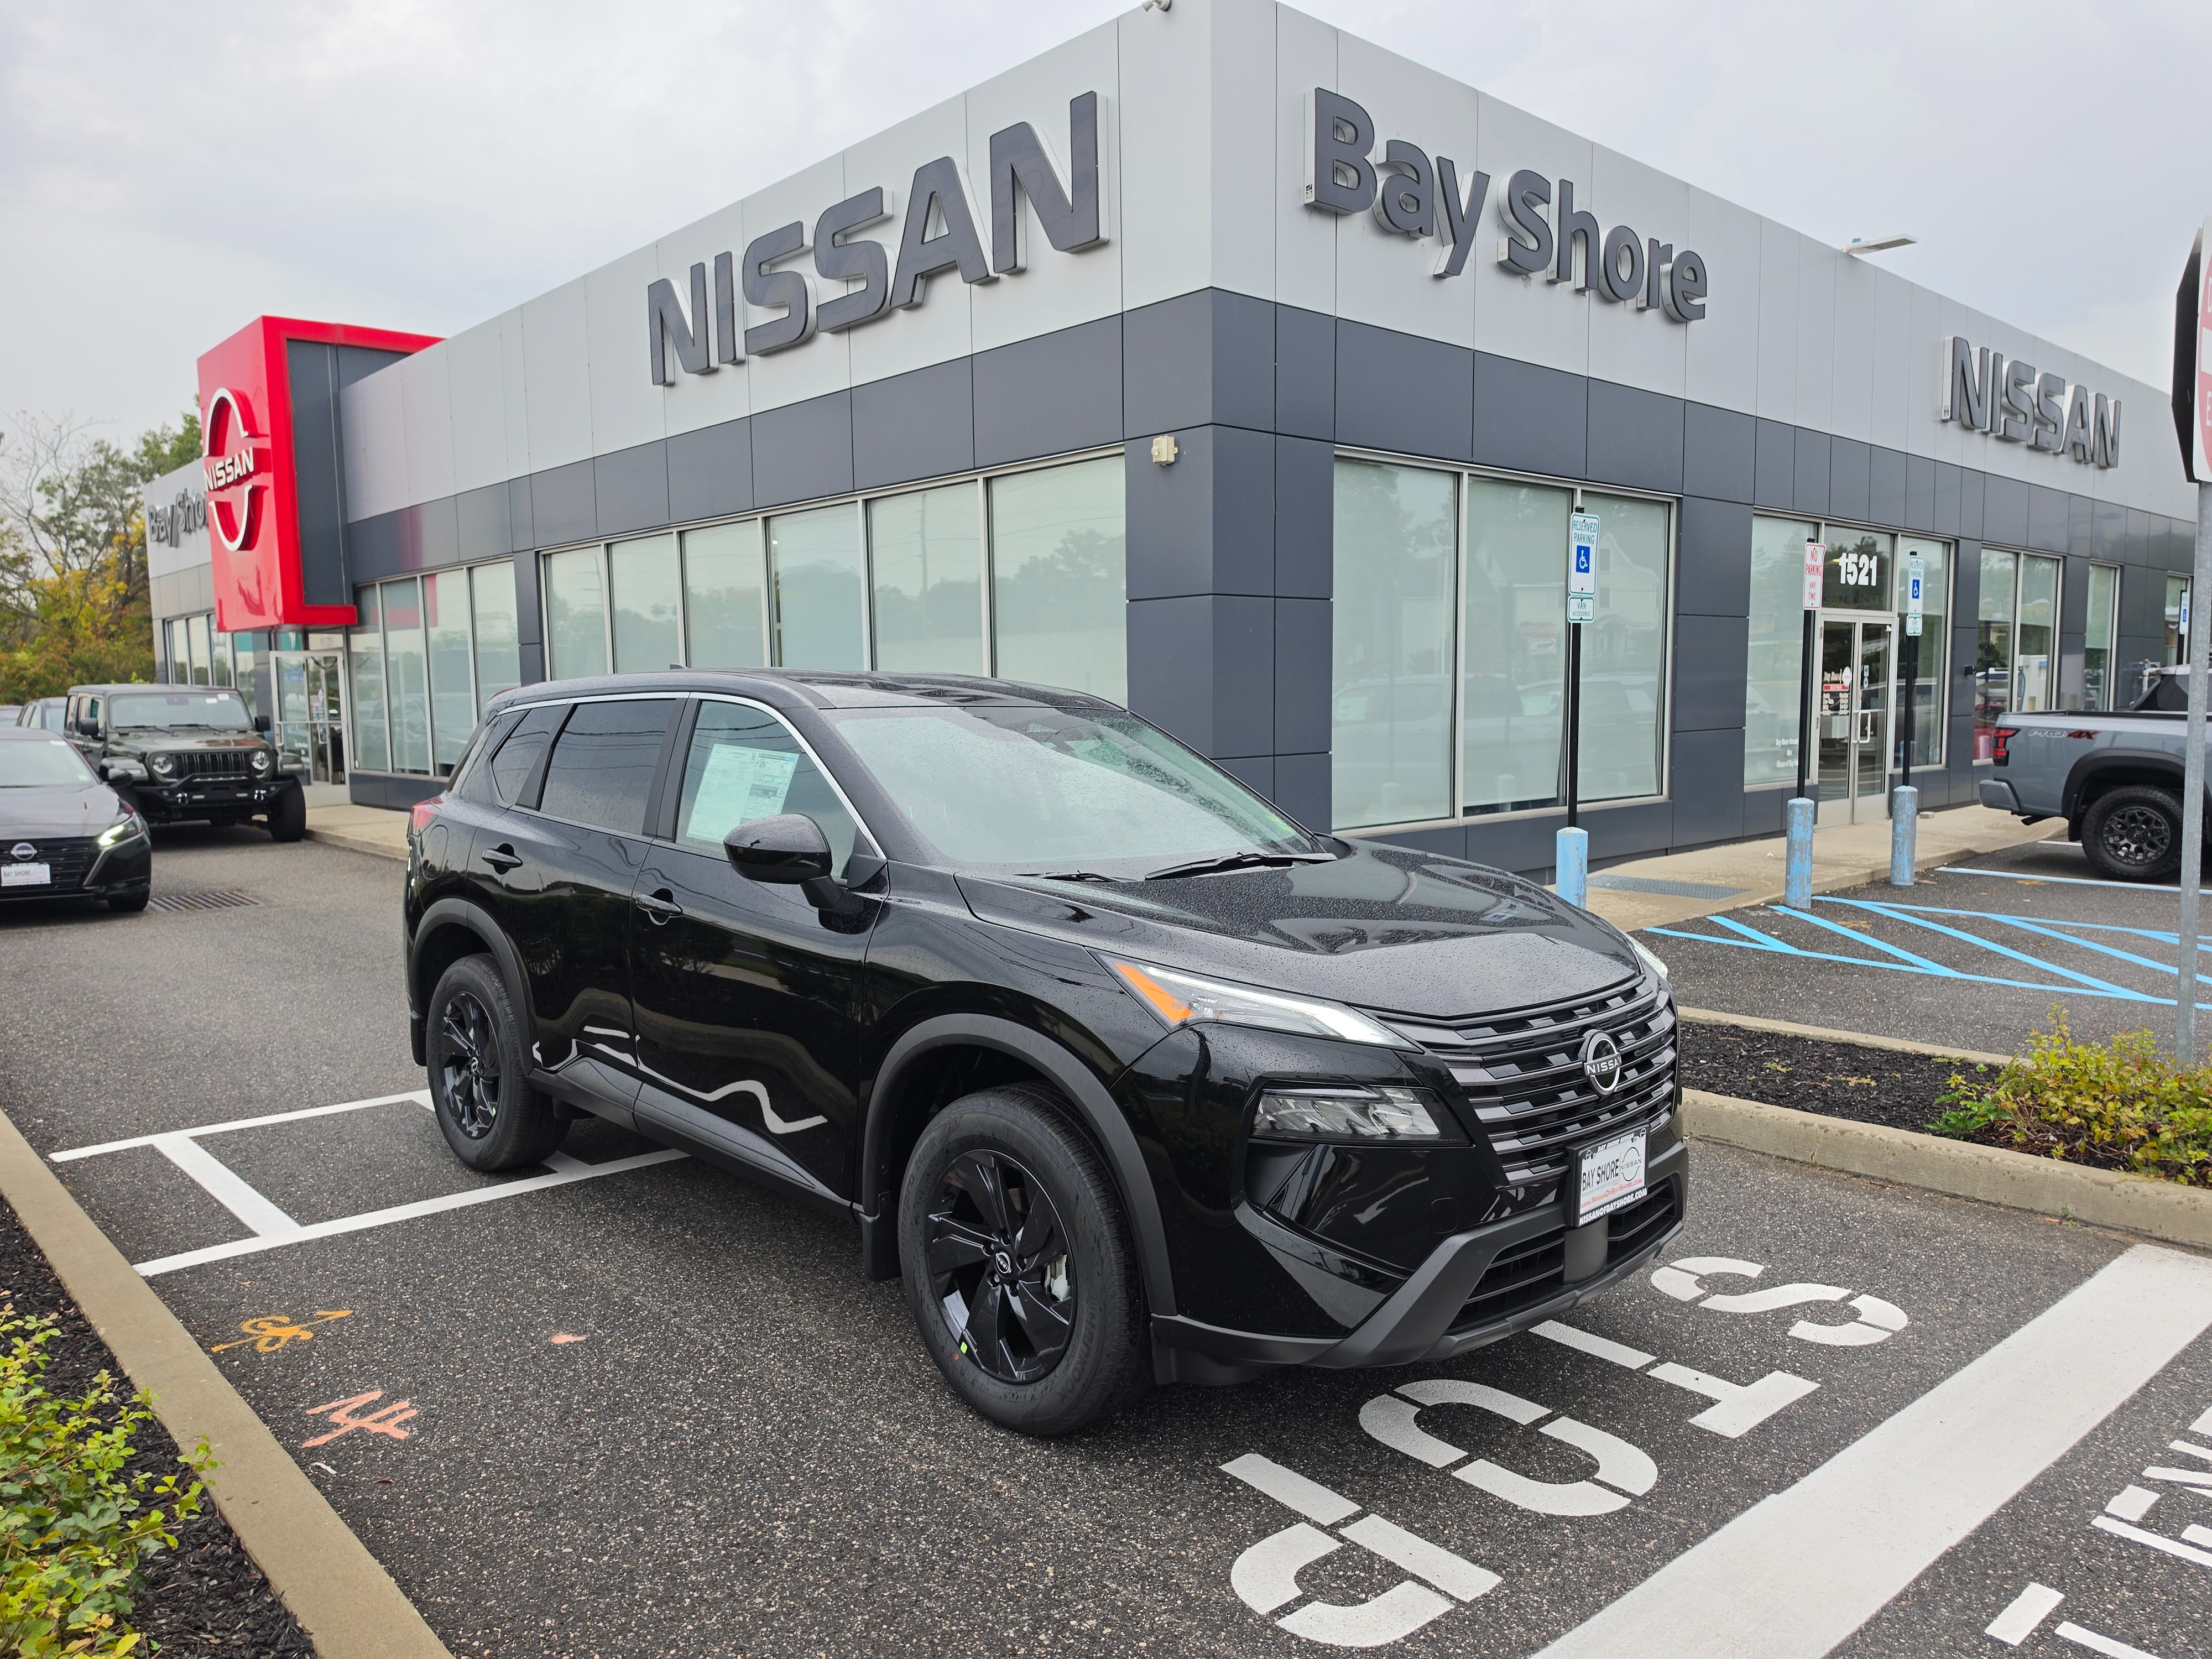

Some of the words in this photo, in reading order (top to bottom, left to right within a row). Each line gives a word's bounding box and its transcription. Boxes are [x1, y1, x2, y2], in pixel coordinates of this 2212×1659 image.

[1305, 87, 1490, 279] Bay
[1498, 169, 1707, 322] Shore
[648, 91, 1109, 387] NISSAN
[1942, 337, 2121, 468] NISSAN
[204, 446, 254, 491] NISSAN
[148, 505, 178, 547] Bay
[176, 488, 208, 533] Sho
[1573, 520, 1597, 533] RESERVED
[1574, 533, 1594, 545] PARKING
[1811, 550, 1818, 562] NO
[1806, 564, 1822, 576] PARKING
[1839, 552, 1877, 586] 1521
[1587, 1056, 1622, 1074] NISSAN
[1582, 1168, 1595, 1191] BAY
[1597, 1159, 1619, 1185] SHORE
[1620, 1158, 1641, 1170] NISSAN
[1579, 1188, 1647, 1225] NISSANOFBAYSHORE.COM
[1219, 1257, 1908, 1647] STOP
